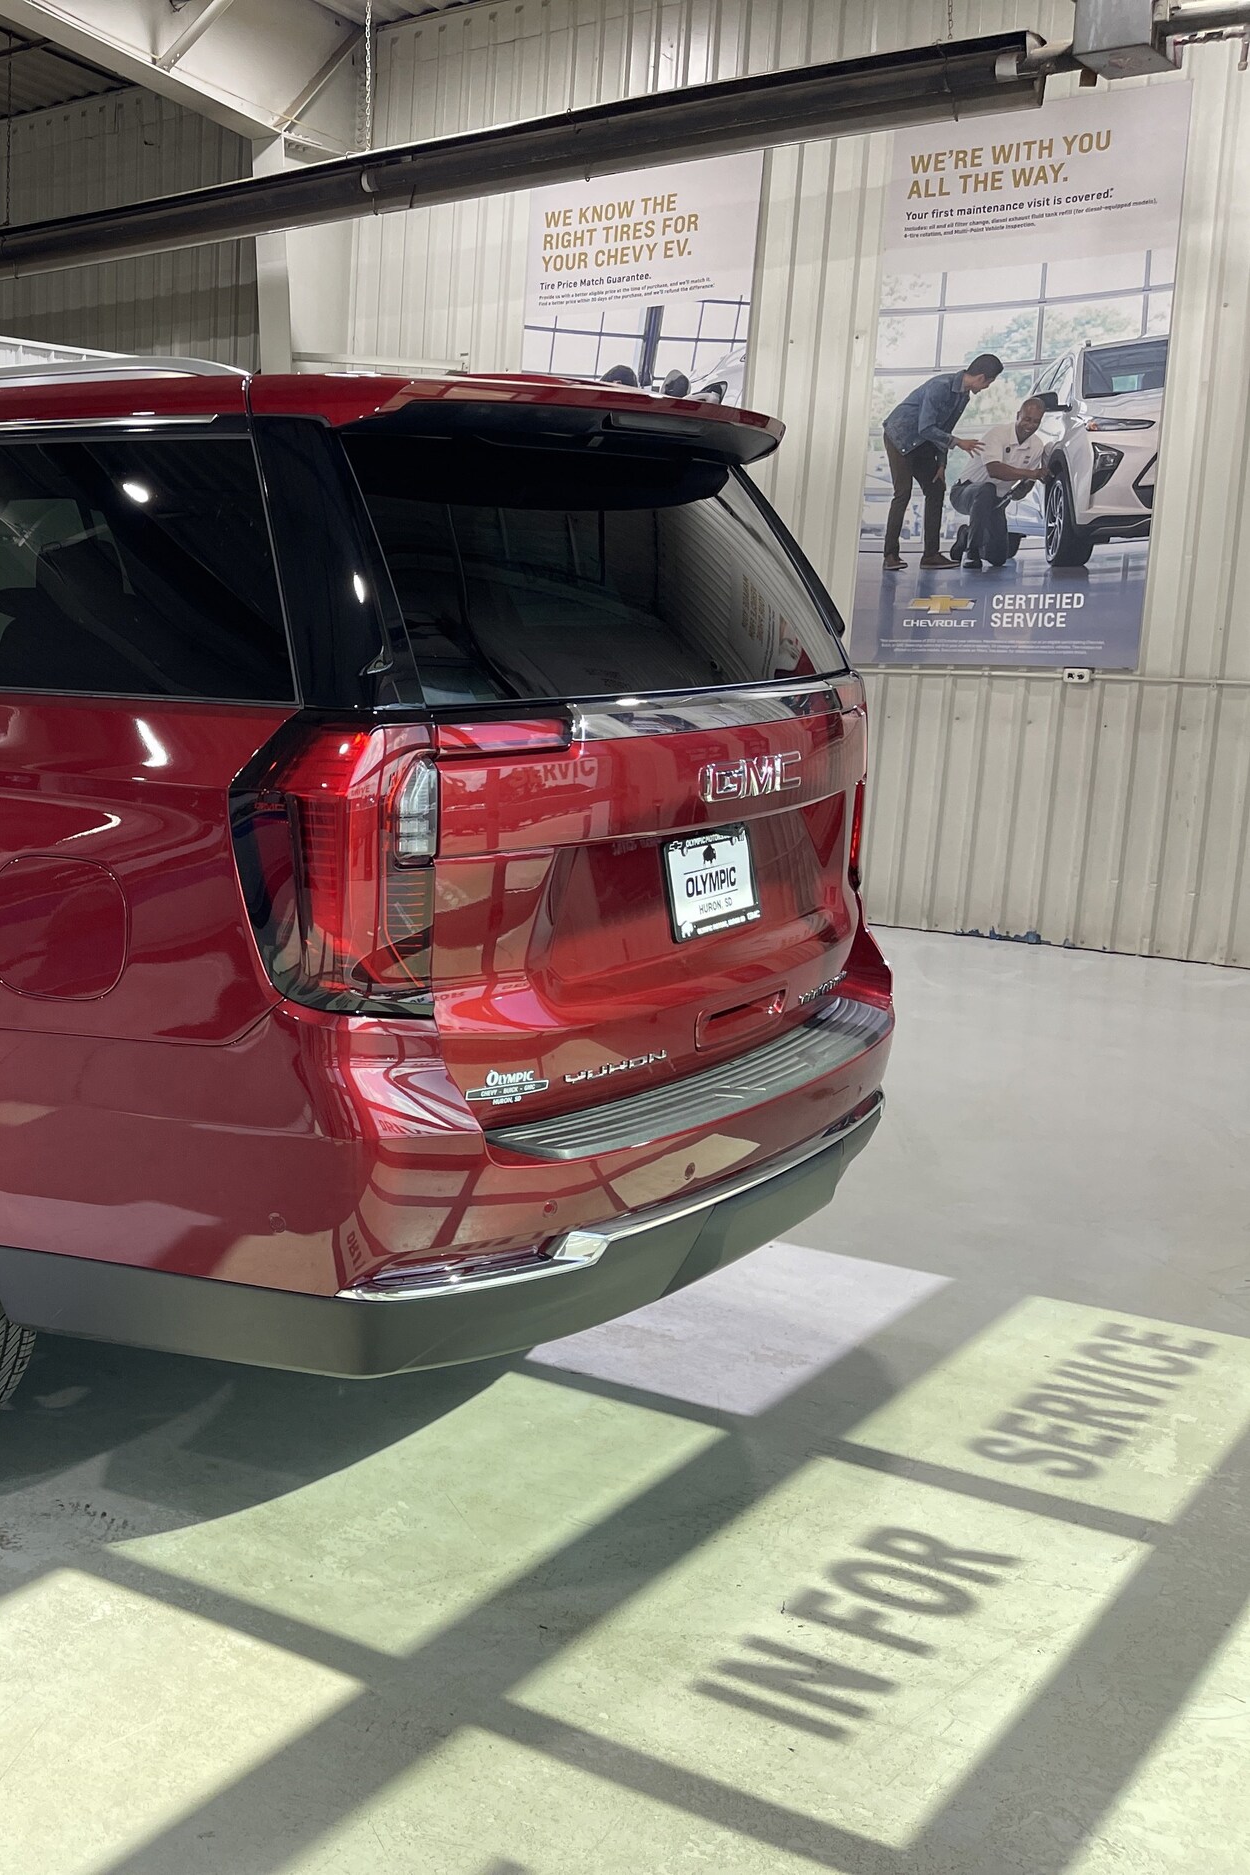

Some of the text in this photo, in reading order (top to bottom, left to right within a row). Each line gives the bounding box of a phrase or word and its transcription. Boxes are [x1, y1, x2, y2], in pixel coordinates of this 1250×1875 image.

[910, 130, 1111, 174] WE'RE WITH YOU
[907, 162, 1069, 200] ALL THE WAY.
[544, 193, 678, 228] WE KNOW THE
[906, 211, 929, 220] Your
[931, 208, 954, 218] first
[956, 202, 1024, 216] maintenance
[1027, 197, 1050, 208] visit
[1053, 196, 1062, 205] is
[542, 213, 699, 251] RIGHT TIRES FOR
[542, 238, 692, 273] YOUR CHEVY EV.
[540, 272, 652, 291] Tire Price Match Guarantee.
[992, 593, 1085, 609] CERTIFIED
[902, 619, 977, 628] CHEVROLET
[990, 612, 1067, 628] SERVICE
[697, 750, 802, 803] GMC
[685, 866, 737, 898] OLYMPIC
[725, 897, 733, 908] SD
[485, 1069, 535, 1087] OLYMPIC
[564, 1050, 667, 1084] YUKON
[480, 1088, 498, 1097] CHEVY
[503, 1086, 519, 1094] BUICK
[969, 1320, 1219, 1481] SERVICE
[690, 1524, 1024, 1742] IN FOR
